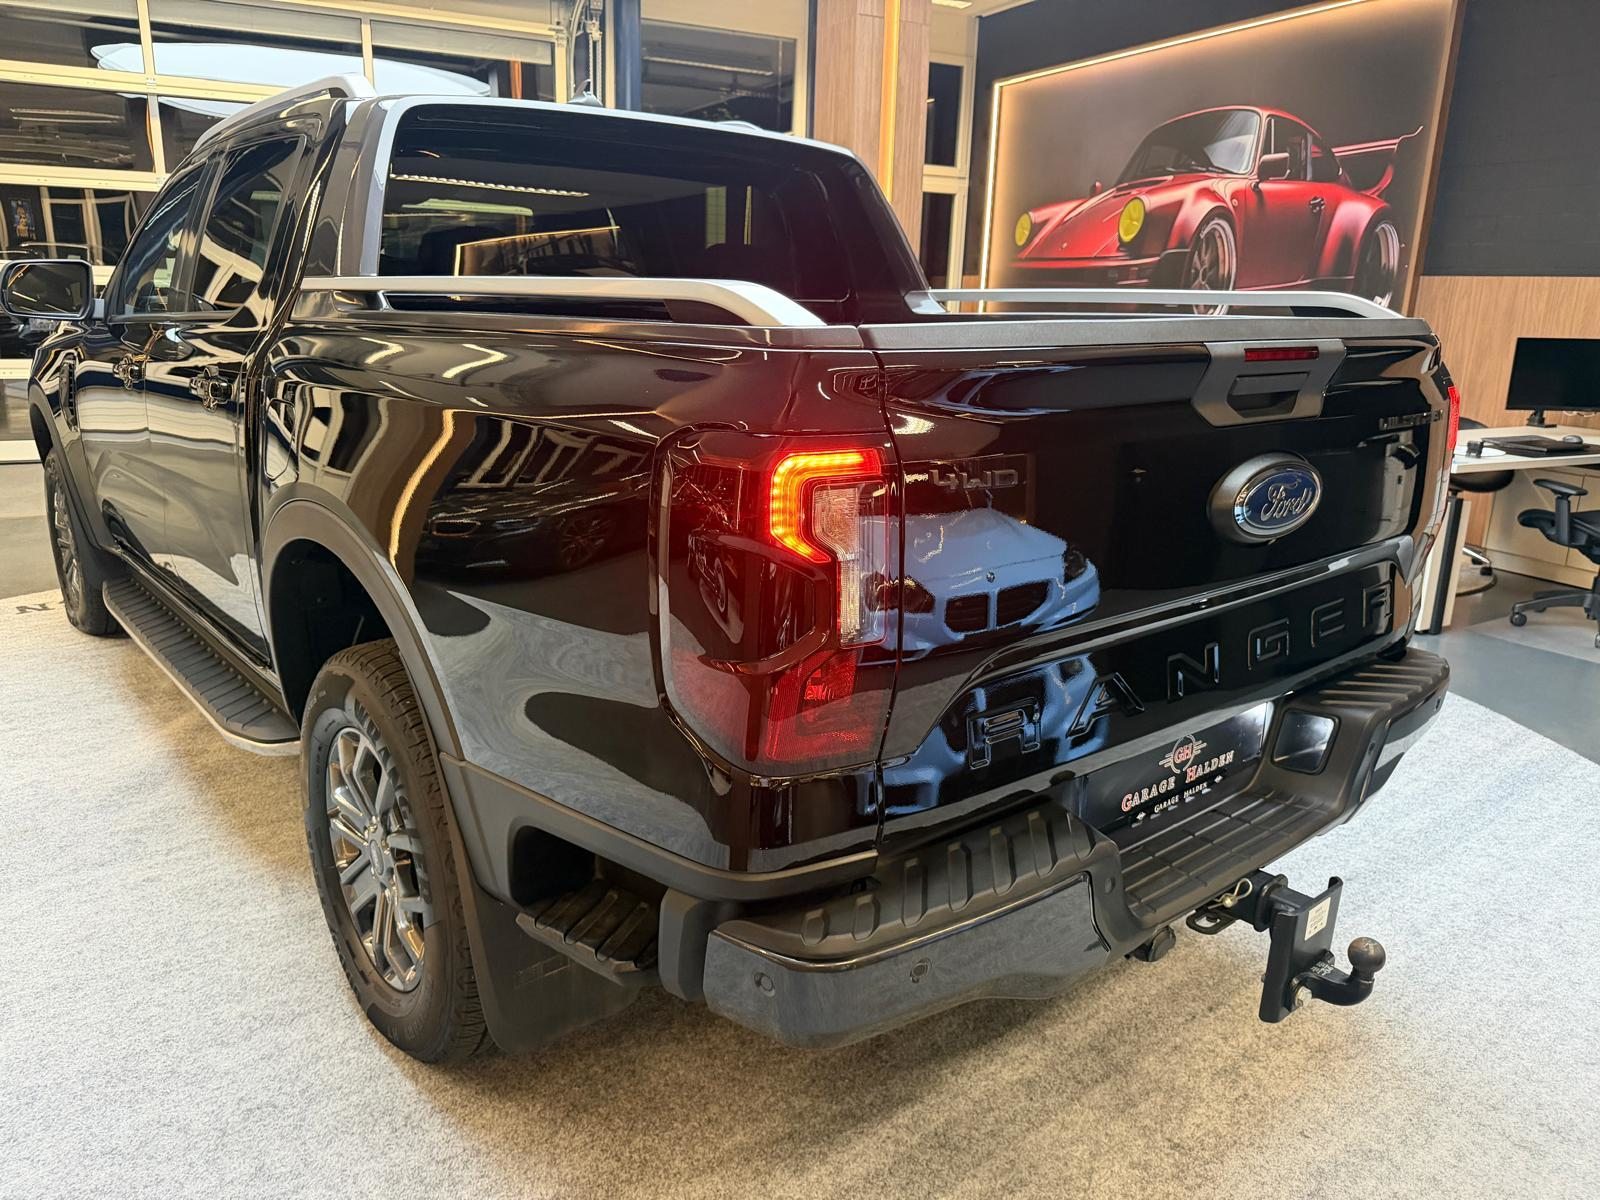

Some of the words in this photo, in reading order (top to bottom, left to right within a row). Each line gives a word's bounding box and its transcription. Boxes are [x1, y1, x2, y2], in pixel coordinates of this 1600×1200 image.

[929, 468, 1019, 491] 4WD
[1260, 478, 1312, 521] Ford
[967, 577, 1395, 769] RANGER
[1173, 742, 1194, 764] GH
[1121, 775, 1176, 812] GARAGE
[1185, 750, 1235, 783] HALDEN
[1154, 794, 1180, 813] GARAGE
[1183, 781, 1208, 798] HALDEN
